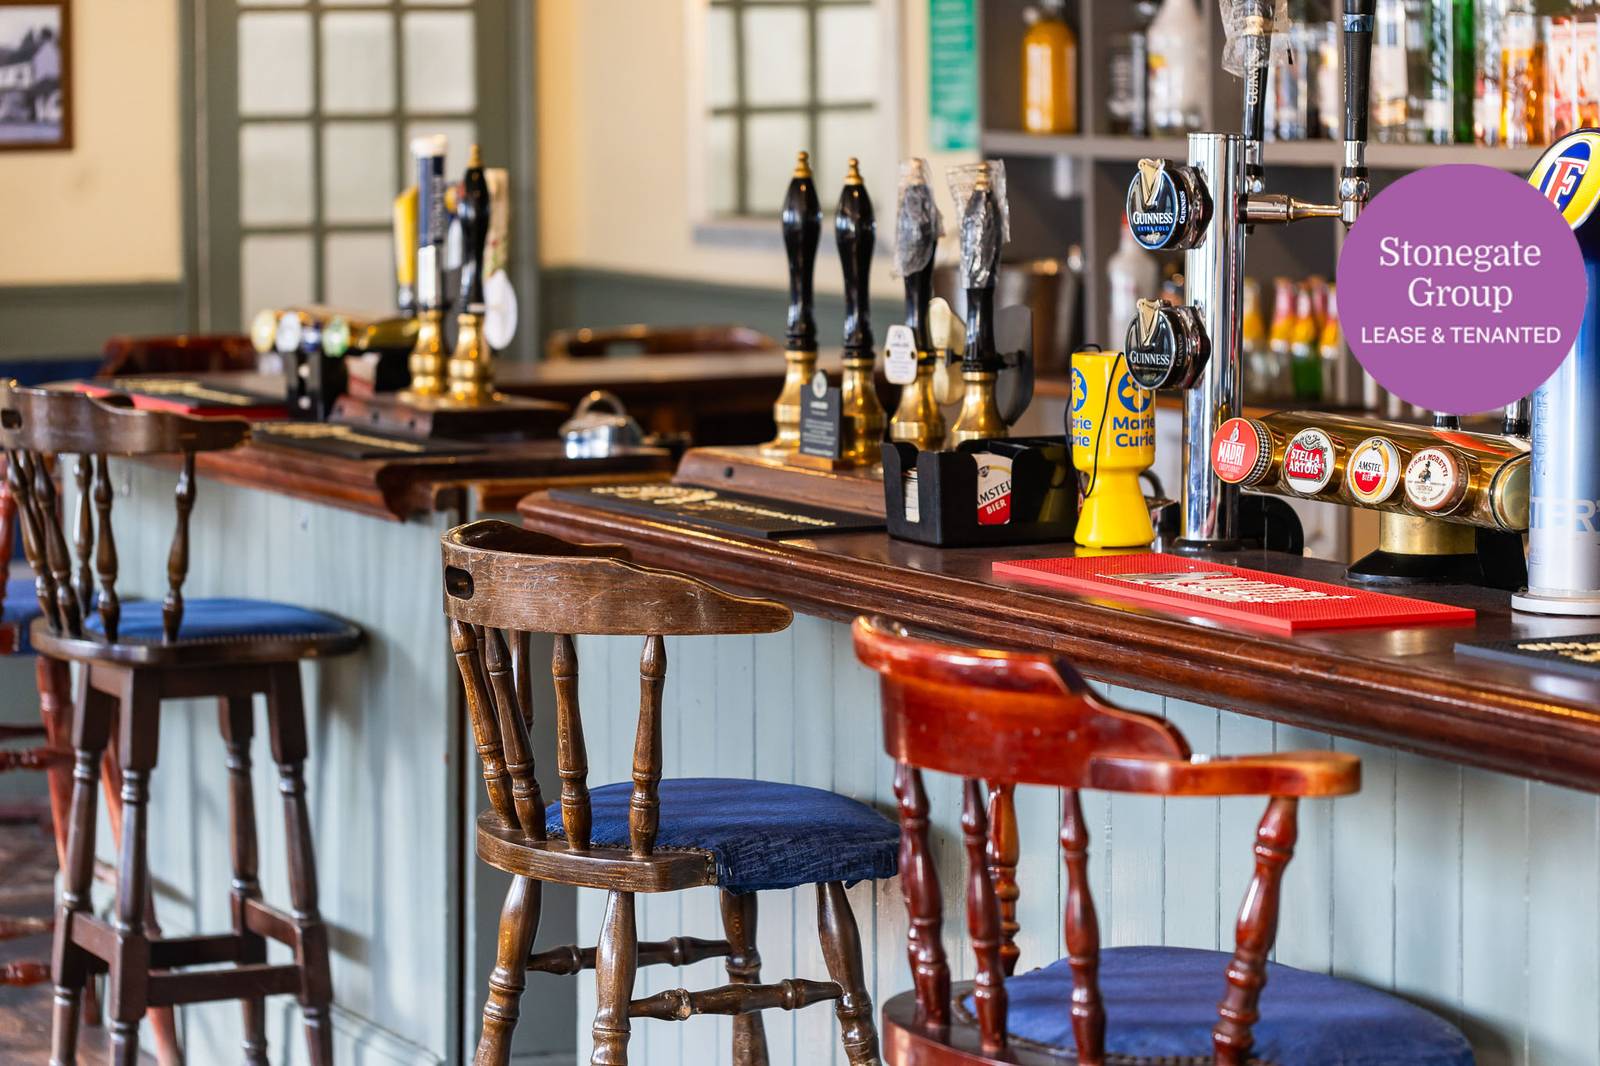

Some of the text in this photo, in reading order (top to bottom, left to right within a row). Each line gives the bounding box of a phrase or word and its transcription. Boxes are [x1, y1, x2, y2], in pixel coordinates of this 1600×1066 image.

[1179, 190, 1187, 225] GUINNESS
[1132, 211, 1174, 225] GUINNESS
[1129, 350, 1170, 366] GUINNESS
[1072, 415, 1093, 430] rie
[1112, 414, 1155, 431] Marie
[1072, 432, 1090, 447] rie
[1115, 431, 1154, 448] Curie
[1290, 448, 1320, 462] STELLA
[1288, 461, 1319, 475] ARTOIS
[1357, 460, 1381, 472] AMSTEL
[1427, 454, 1449, 477] MORETTI
[986, 498, 1007, 515] BIER
